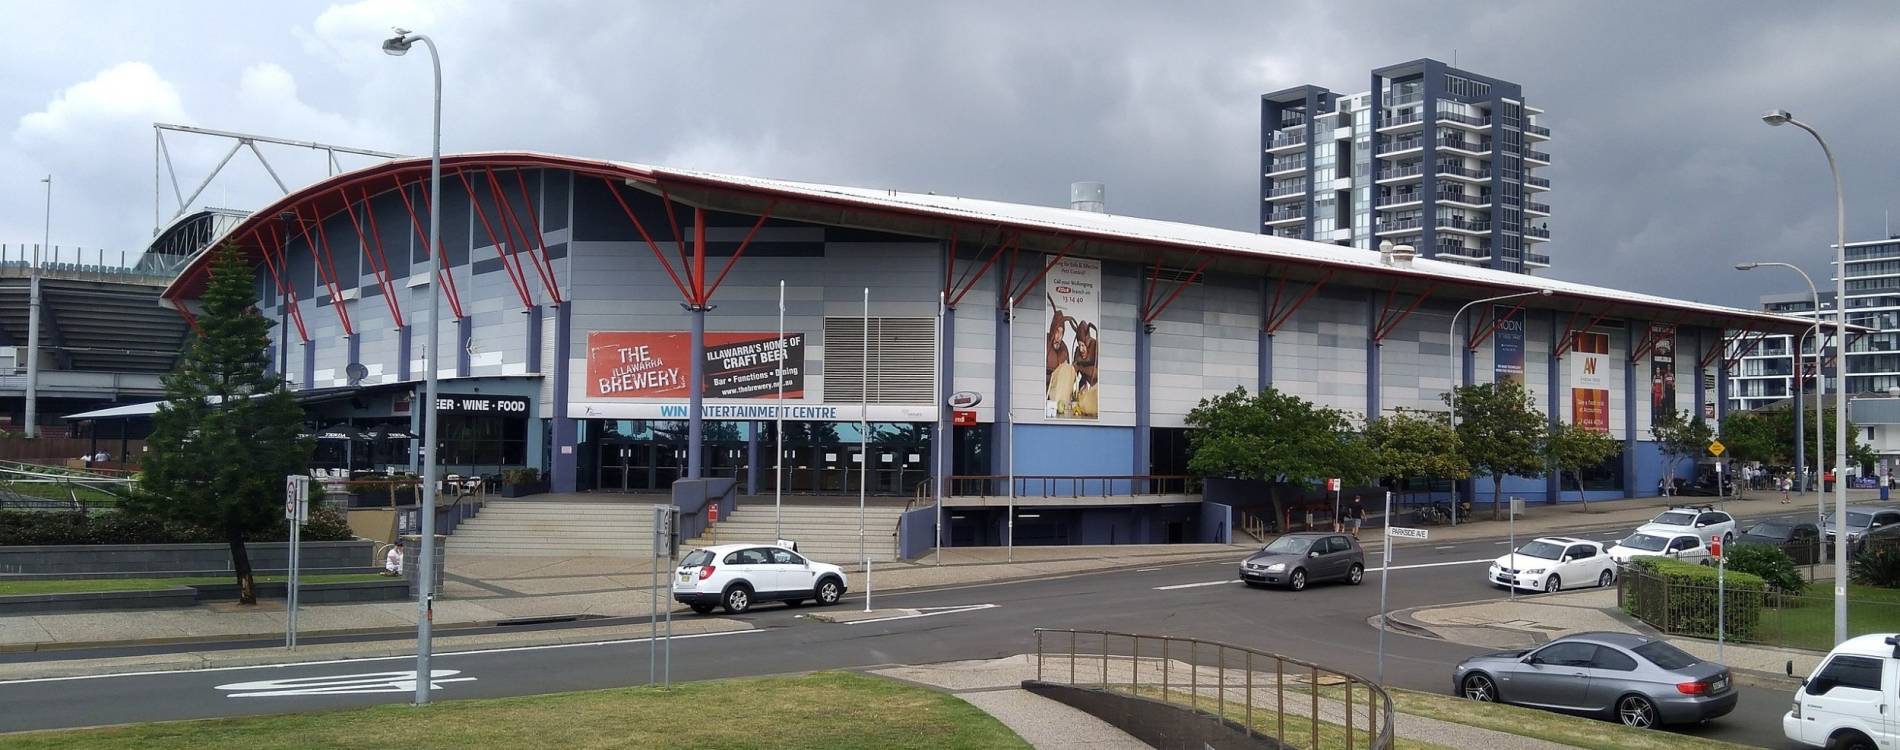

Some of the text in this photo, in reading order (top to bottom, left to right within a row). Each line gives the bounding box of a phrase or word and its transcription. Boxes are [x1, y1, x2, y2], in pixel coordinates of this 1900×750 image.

[618, 346, 650, 363] THE
[706, 344, 762, 360] ILLAWARRA'S
[790, 336, 800, 346] OF
[612, 357, 664, 377] ILLAWARRA
[724, 349, 788, 370] CRAFT BEER
[598, 368, 679, 394] BREWERY
[713, 378, 726, 386] Bar
[732, 372, 768, 383] Functions
[462, 400, 490, 411] WINE
[498, 400, 525, 411] FOOD
[660, 406, 687, 417] WIN
[793, 406, 836, 418] CENTRE
[1392, 528, 1416, 537] PARKSIDE
